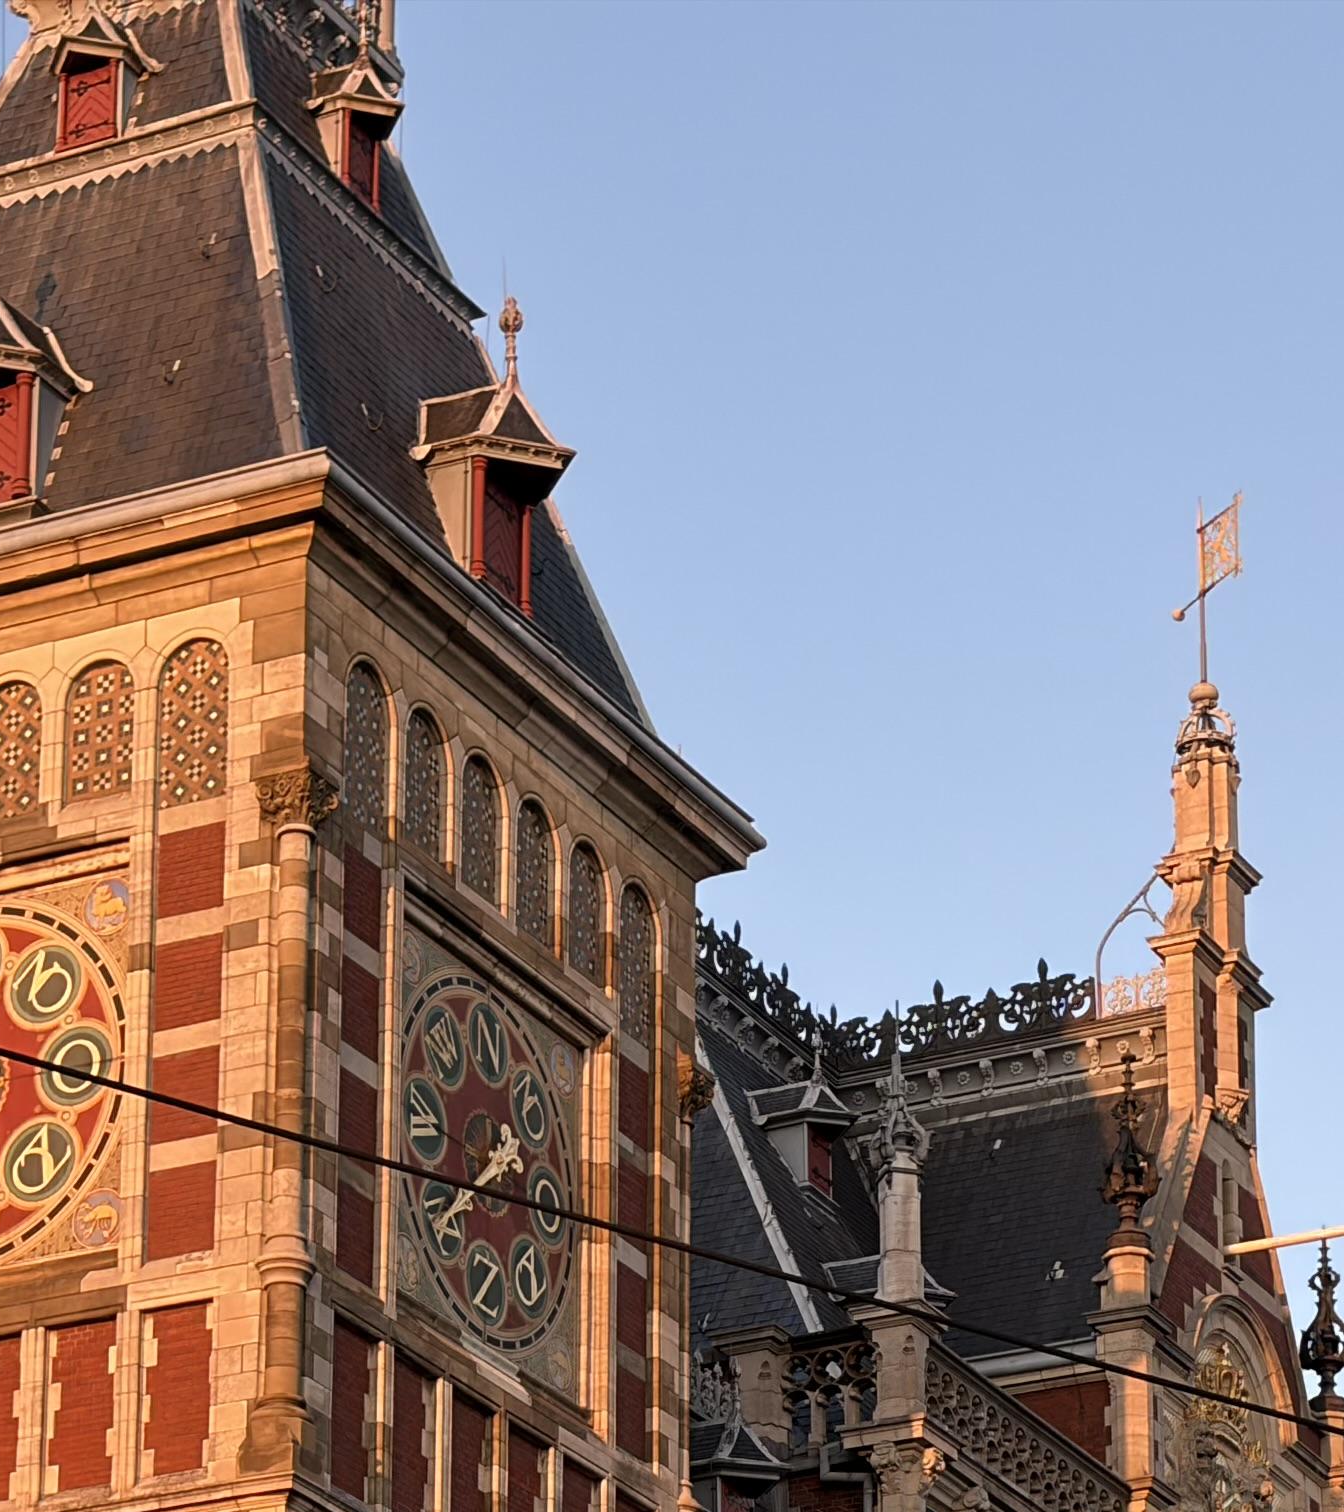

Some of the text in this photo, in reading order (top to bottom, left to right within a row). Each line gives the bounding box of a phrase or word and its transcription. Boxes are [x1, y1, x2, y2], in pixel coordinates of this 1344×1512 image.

[52, 1039, 100, 1094] O
[476, 1010, 502, 1075] N
[535, 1178, 561, 1233] O
